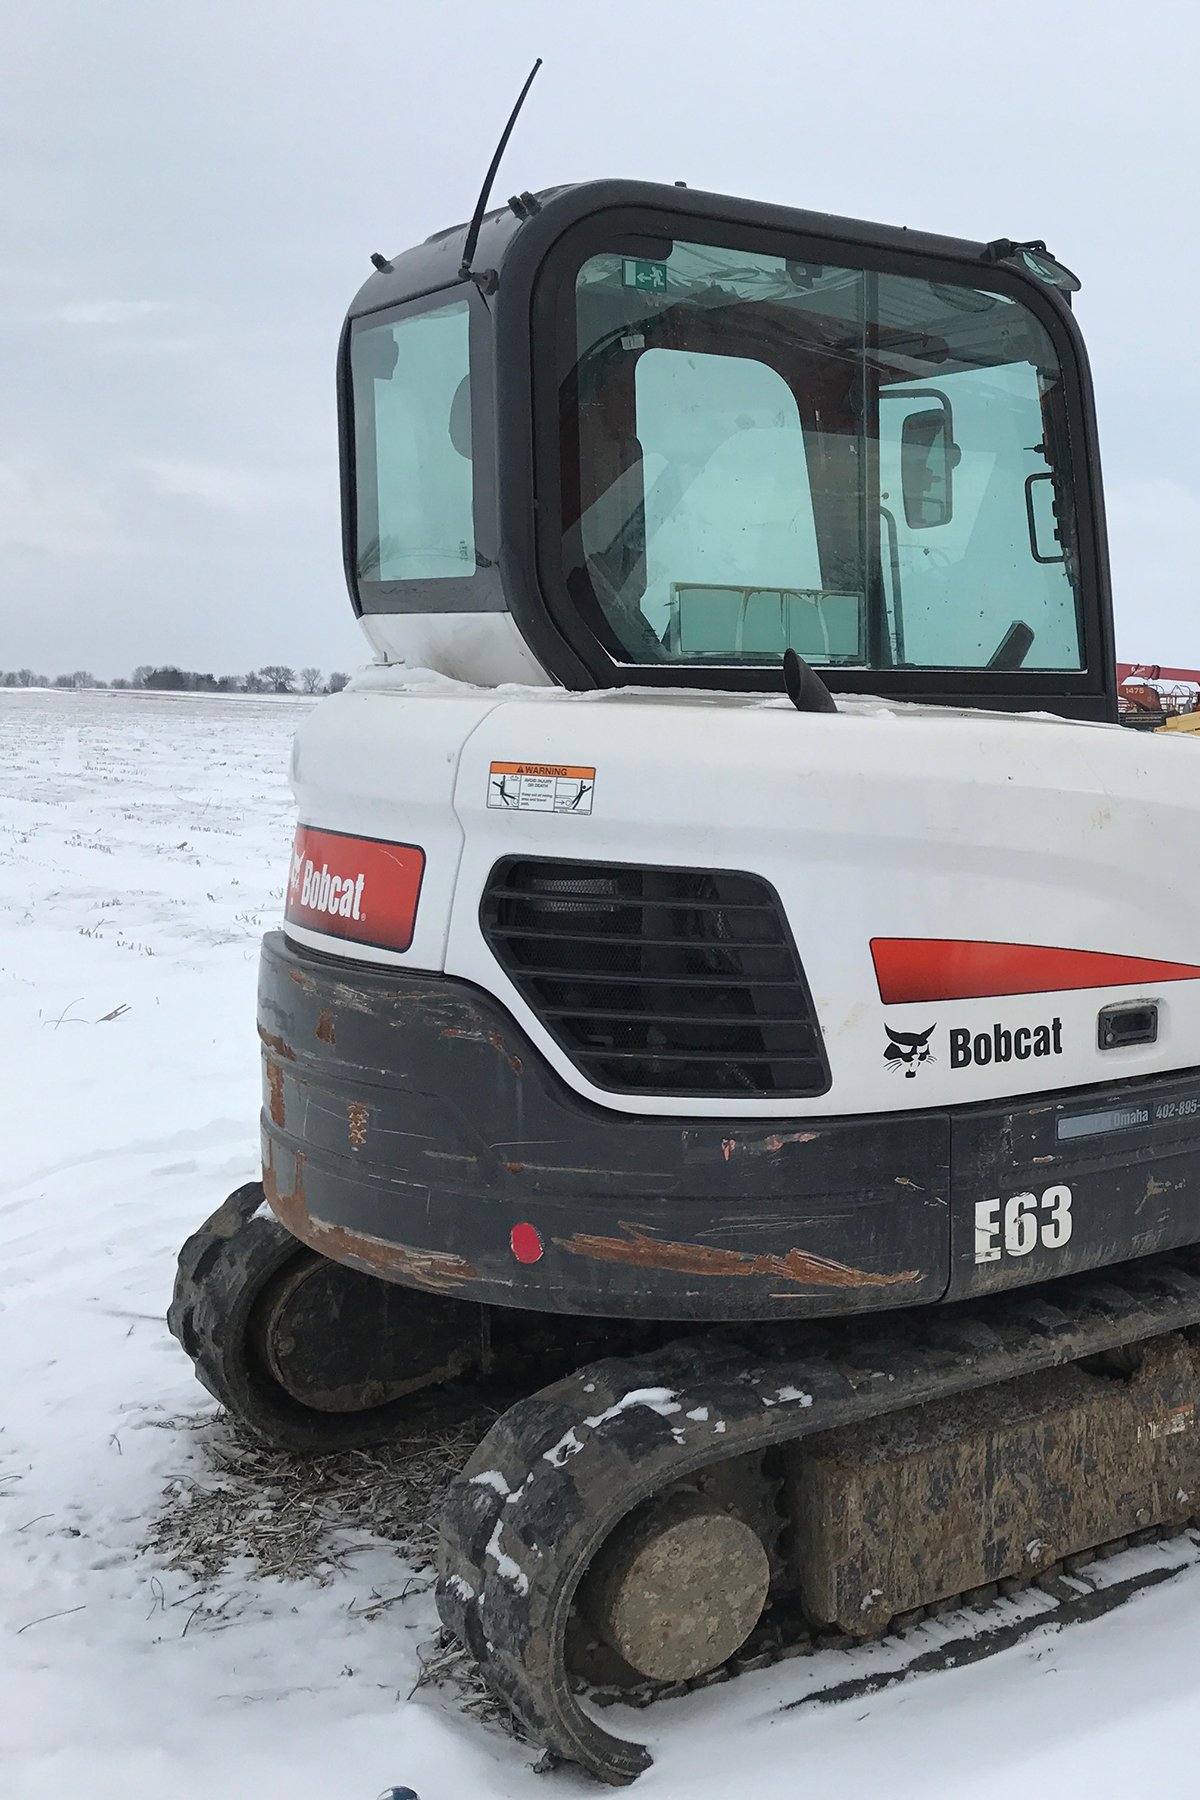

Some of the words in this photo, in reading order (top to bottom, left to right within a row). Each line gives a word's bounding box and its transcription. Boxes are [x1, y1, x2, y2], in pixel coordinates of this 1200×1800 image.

[525, 767, 568, 776] WARNING
[301, 859, 365, 921] Bobcat
[949, 1017, 1063, 1070] Bobcat
[1114, 1109, 1150, 1128] Omaha
[974, 1185, 1073, 1265] E63
